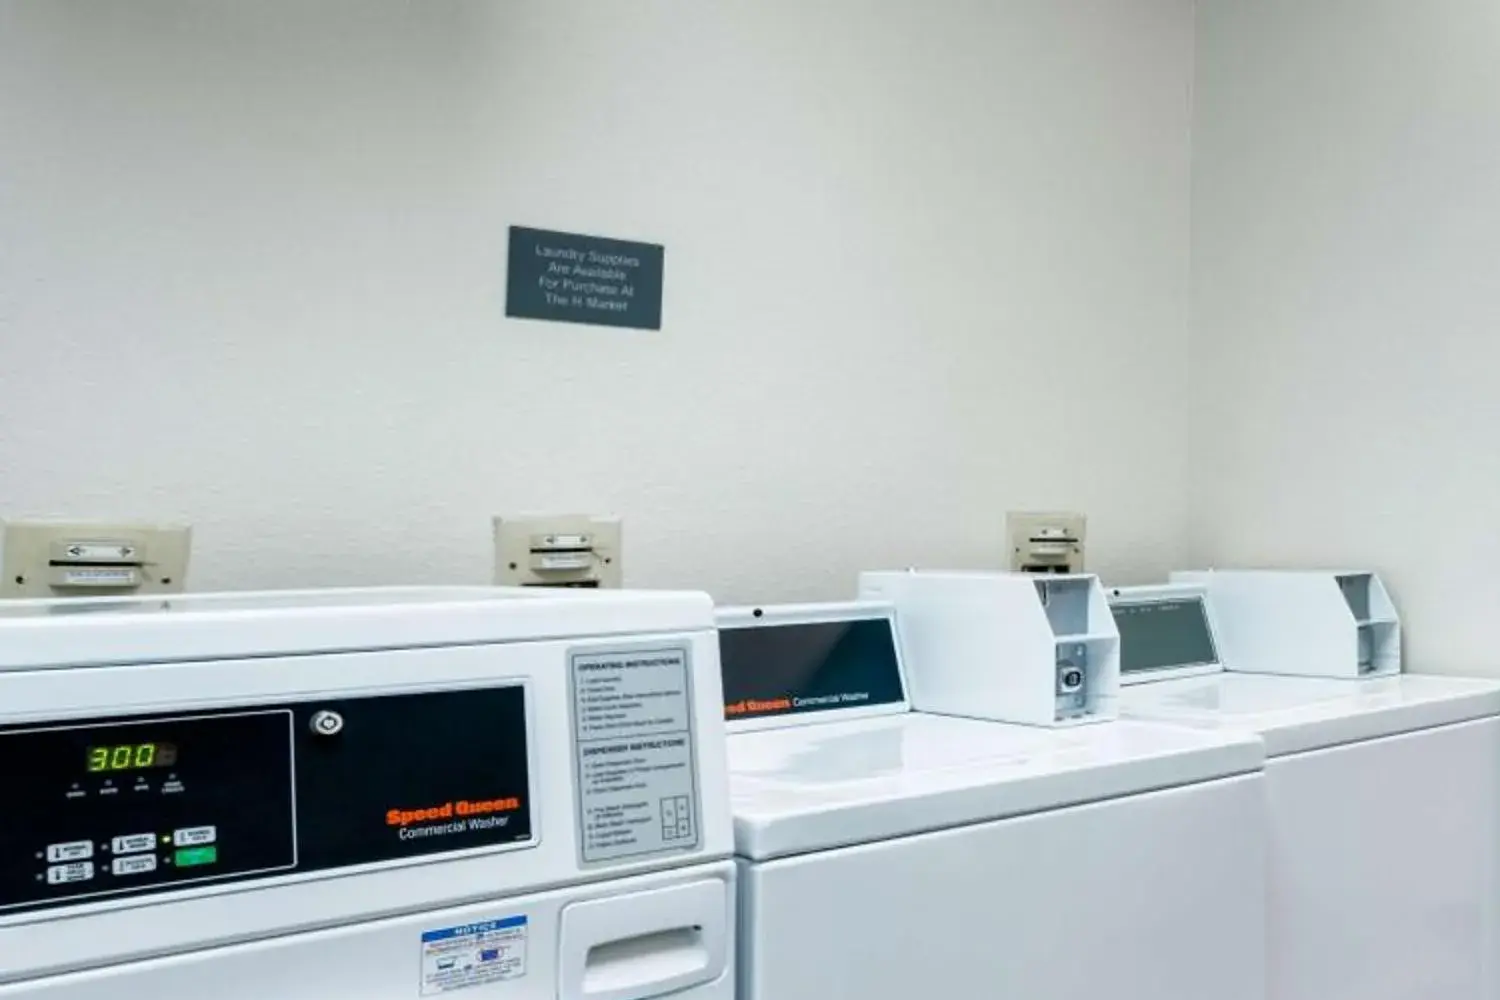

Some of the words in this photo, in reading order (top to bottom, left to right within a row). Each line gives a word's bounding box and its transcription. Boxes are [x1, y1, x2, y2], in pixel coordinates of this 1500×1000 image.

[535, 244, 585, 262] Laundry
[588, 251, 640, 268] Supplies
[548, 261, 569, 275] Are
[573, 264, 627, 281] Available
[538, 275, 559, 289] For
[562, 279, 618, 295] Purchase
[621, 285, 635, 297] At
[545, 291, 569, 306] The
[572, 296, 583, 307] H
[586, 297, 628, 312] Market
[89, 743, 155, 772] 300
[386, 802, 452, 826] Speed
[455, 797, 519, 816] Queen
[399, 819, 467, 840] Commercial
[469, 815, 509, 830] Washer
